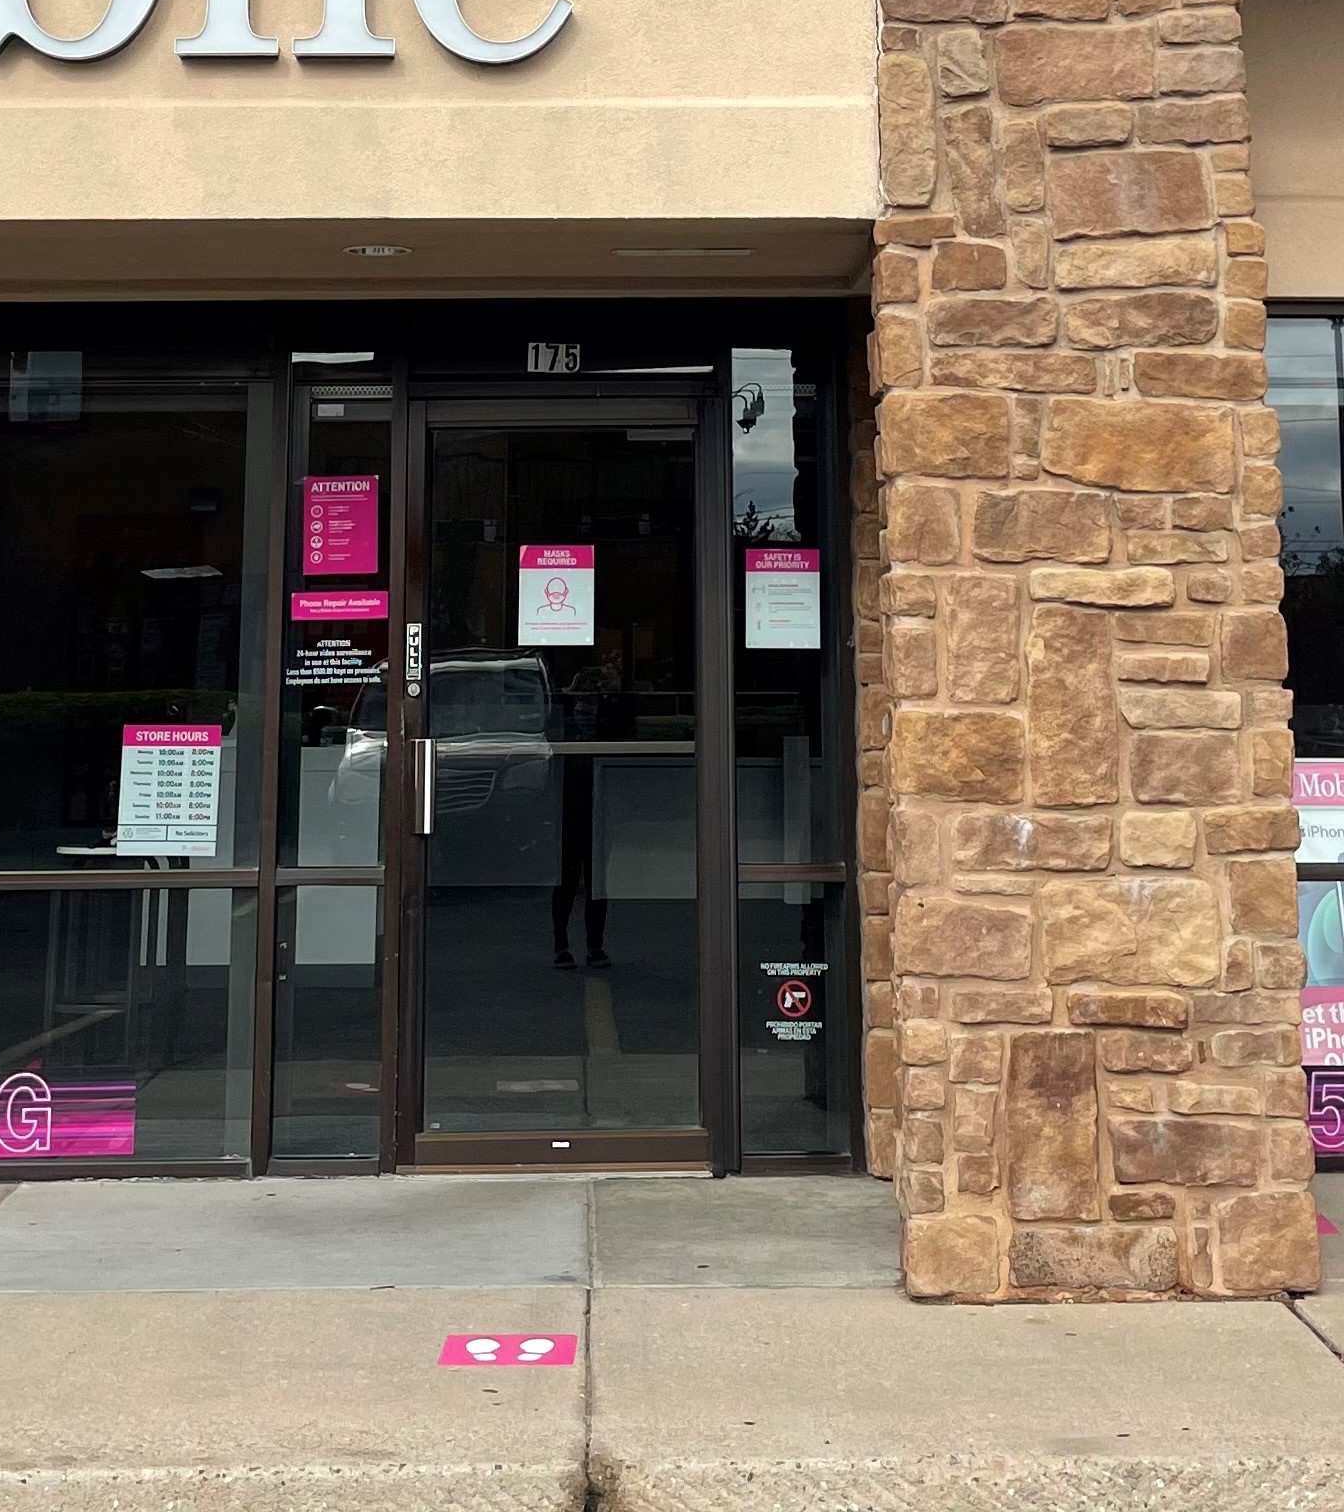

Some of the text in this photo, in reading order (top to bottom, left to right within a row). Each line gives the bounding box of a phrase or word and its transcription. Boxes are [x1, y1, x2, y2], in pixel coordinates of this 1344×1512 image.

[531, 343, 578, 372] 175
[311, 480, 370, 493] ATTENTION
[544, 550, 570, 558] MASKS
[764, 553, 802, 561] SAFETY IS
[537, 558, 577, 566] REQUIRED
[774, 561, 809, 569] PRIORITY
[299, 598, 381, 609] Phone Repair Available
[409, 626, 419, 668] PULL
[136, 731, 209, 742] STORE HOURS
[1303, 1002, 1324, 1025] et
